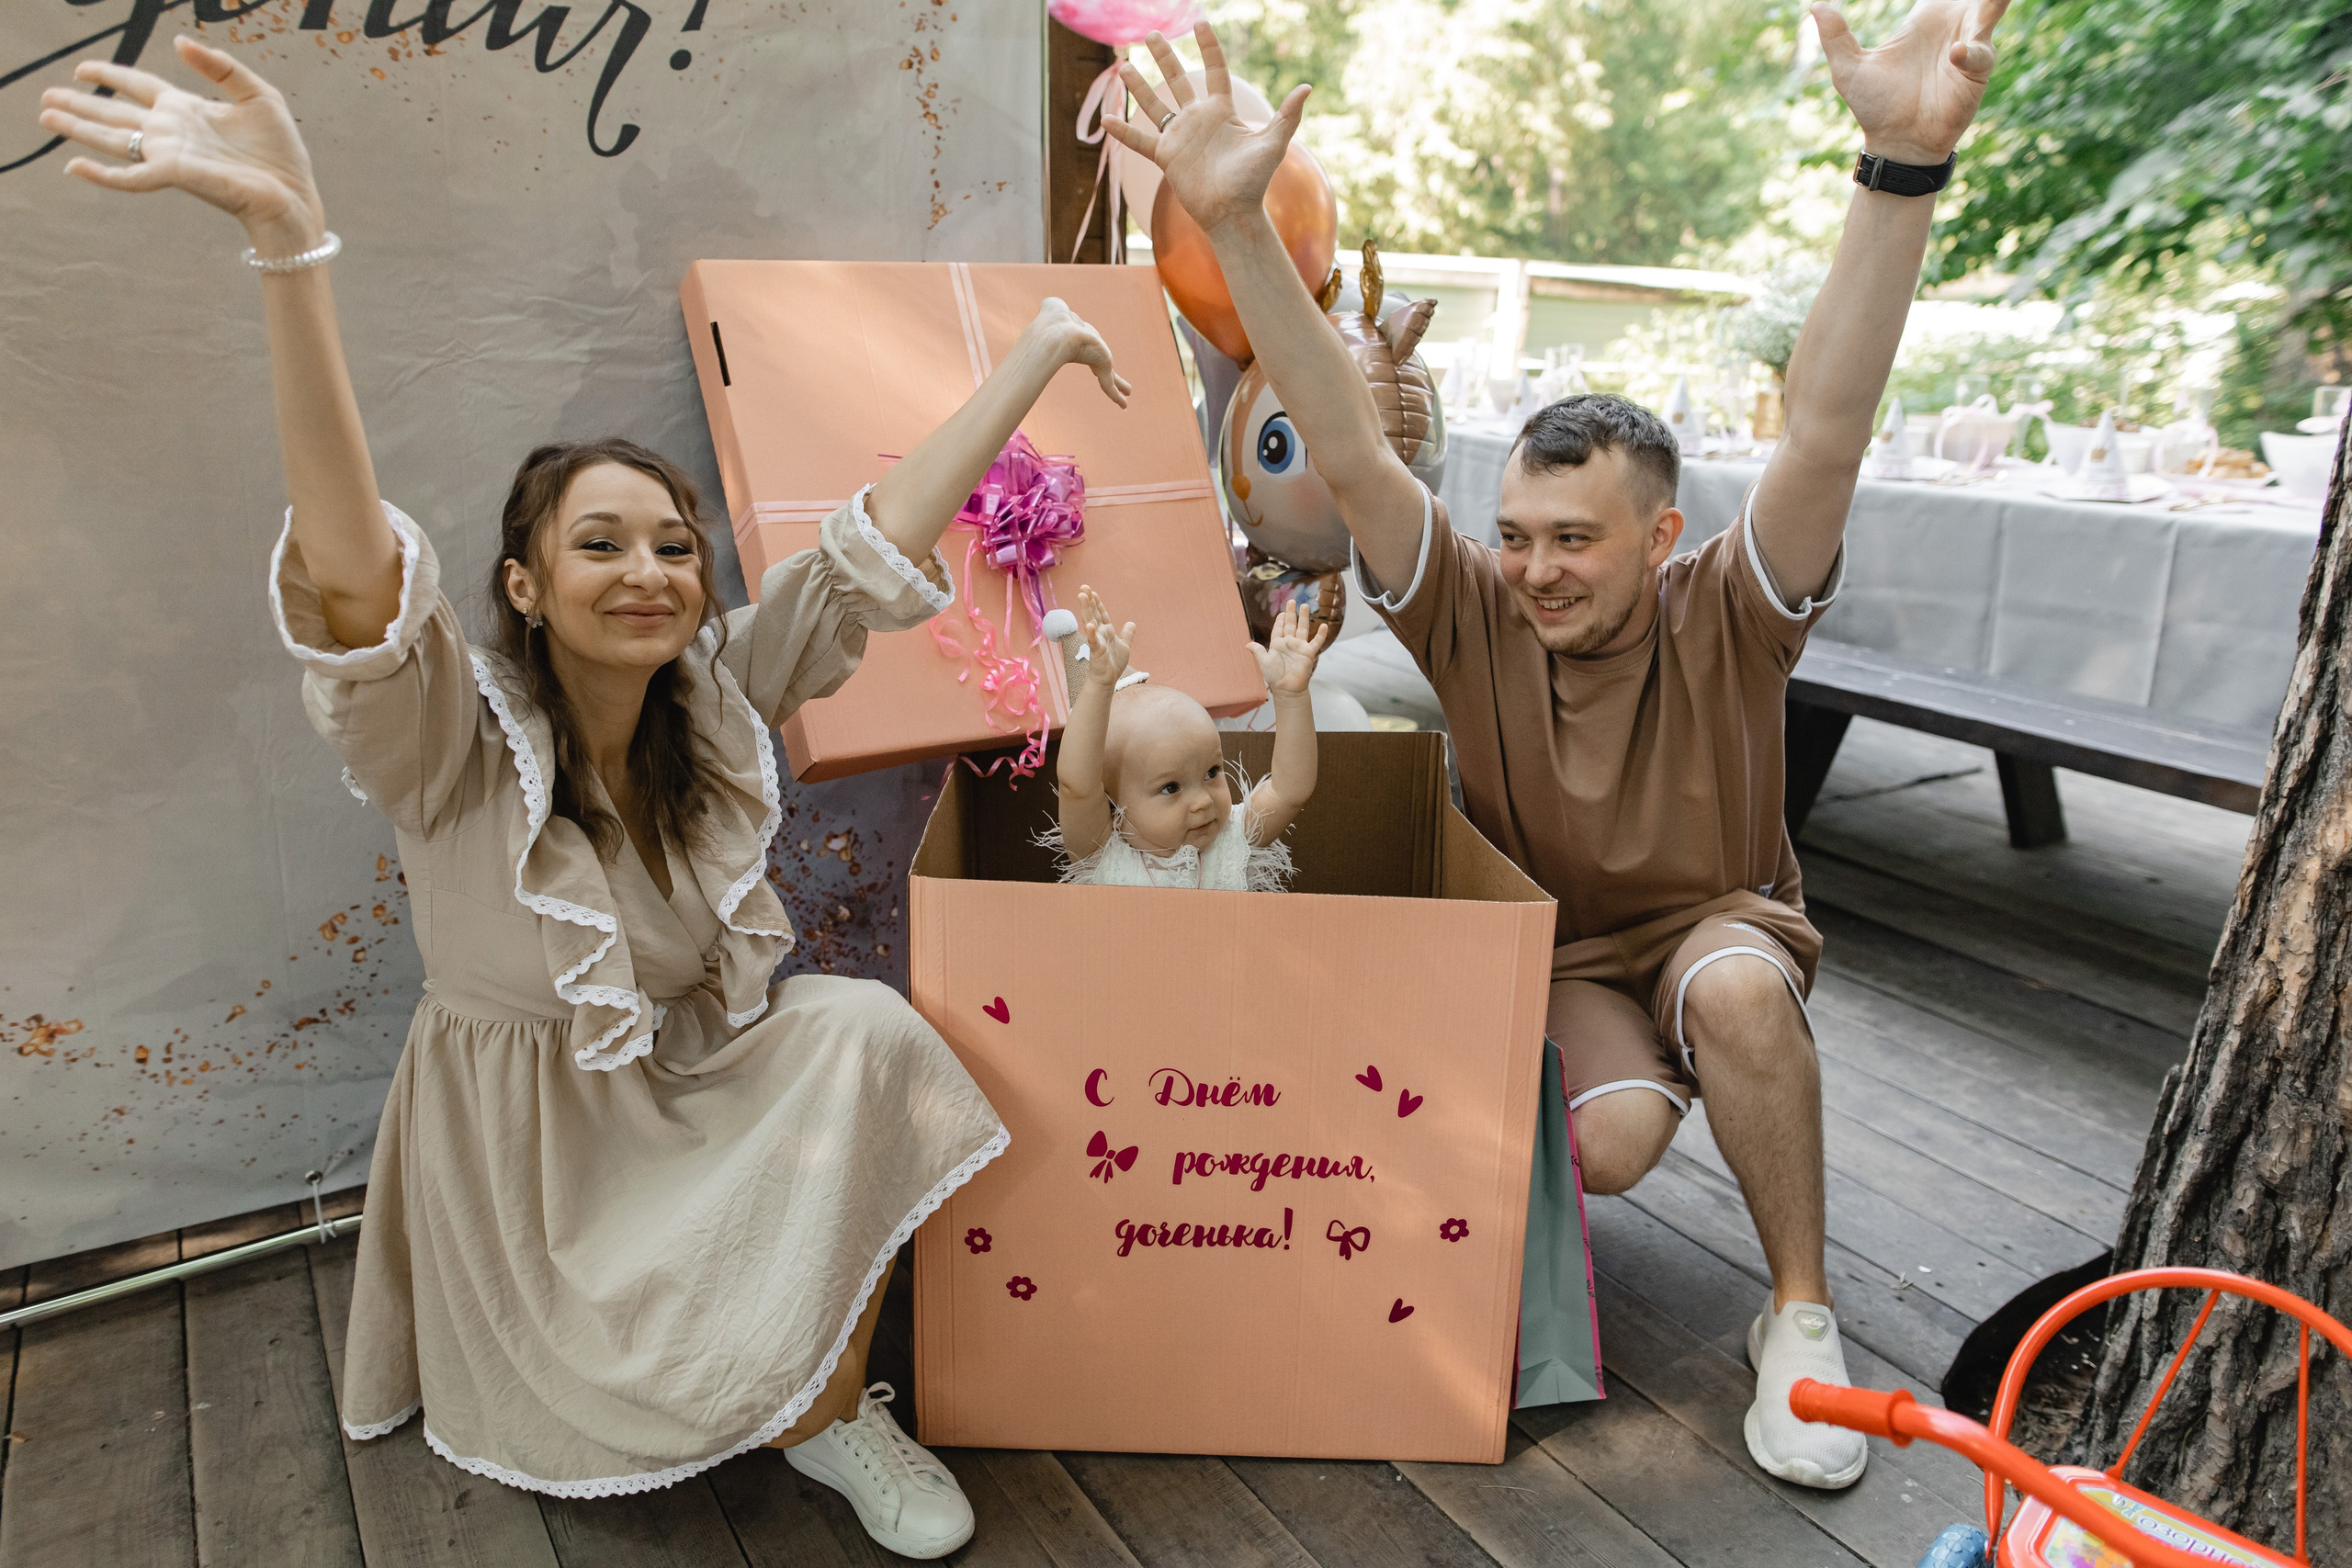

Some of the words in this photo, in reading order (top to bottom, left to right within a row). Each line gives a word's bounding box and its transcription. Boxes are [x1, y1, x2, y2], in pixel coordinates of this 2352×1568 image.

[1084, 1068, 1114, 1108] С
[1148, 1067, 1282, 1108] Днём
[1172, 1152, 1376, 1192] рождения,
[1114, 1207, 1294, 1258] доченька!
[2139, 1516, 2264, 1568] озорно
